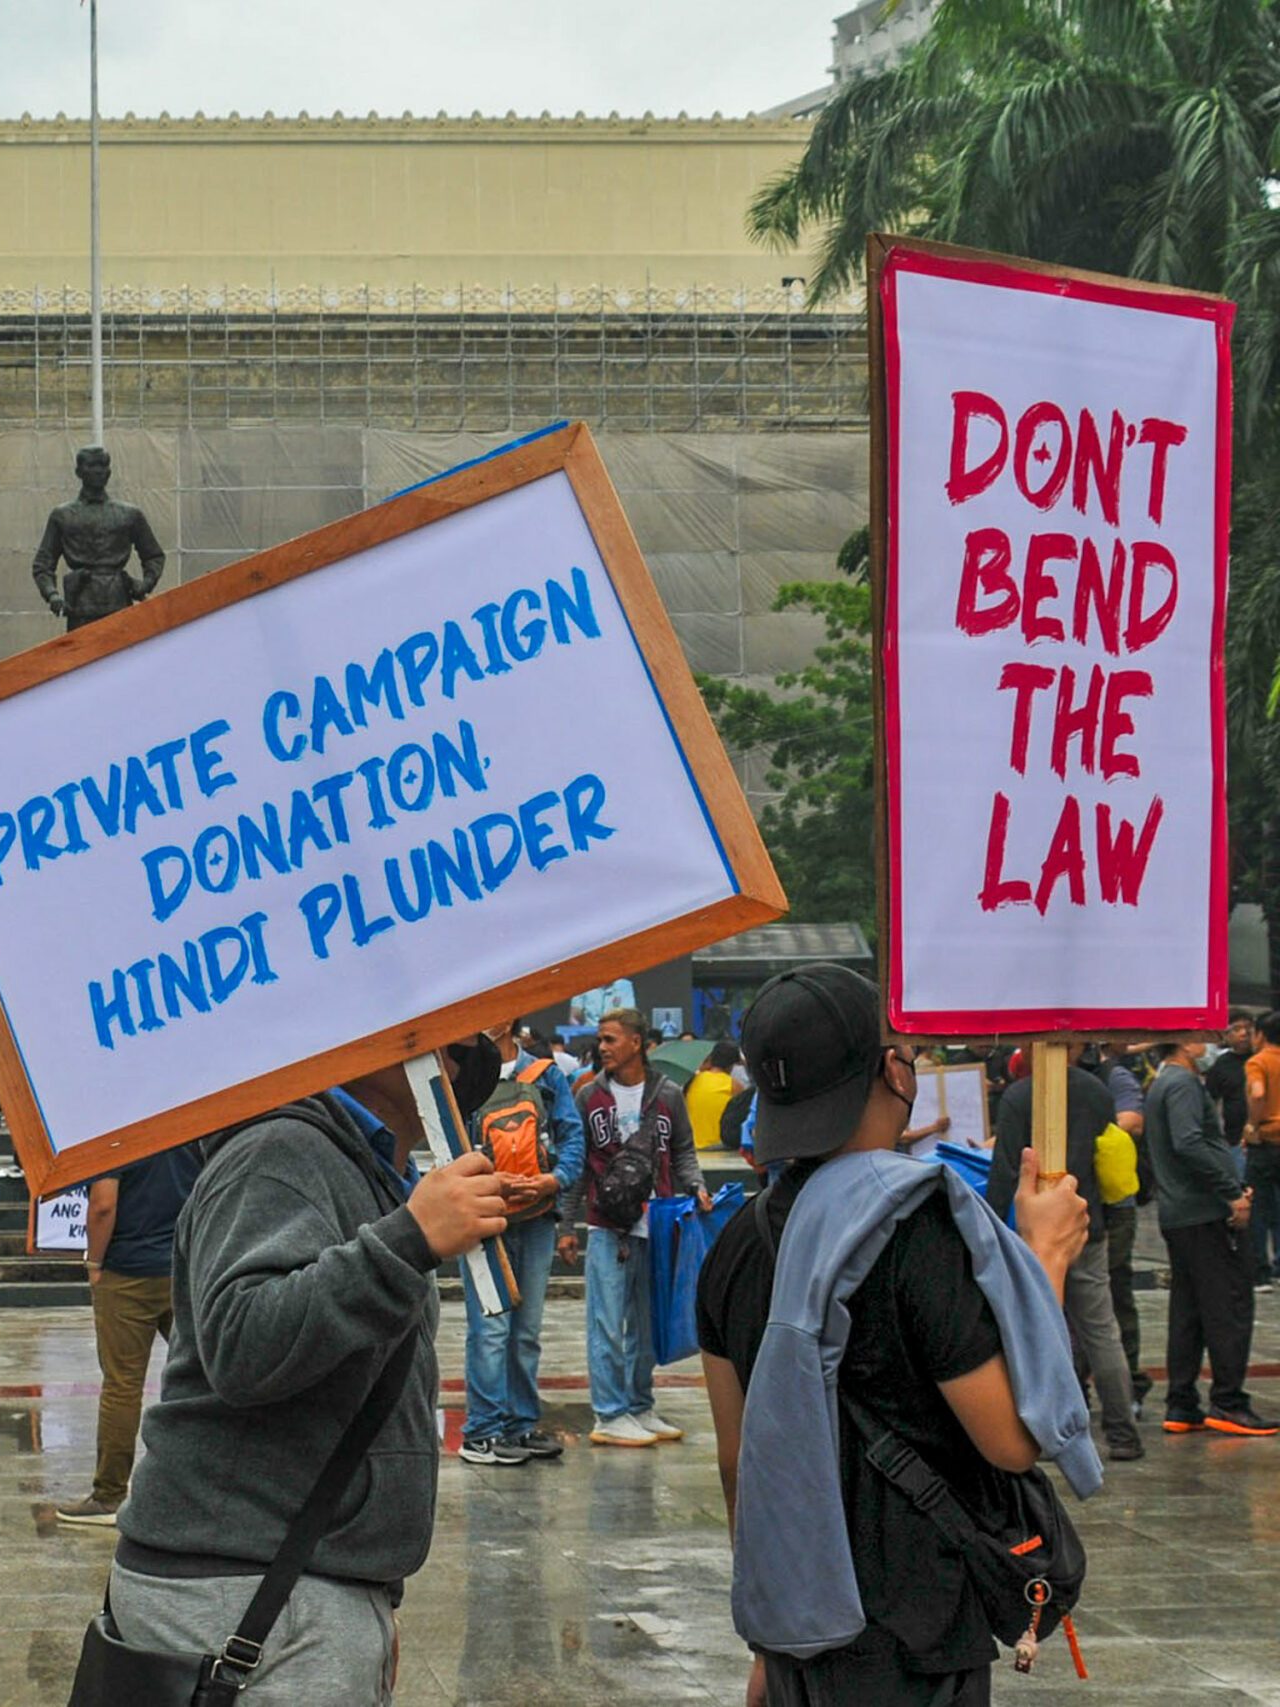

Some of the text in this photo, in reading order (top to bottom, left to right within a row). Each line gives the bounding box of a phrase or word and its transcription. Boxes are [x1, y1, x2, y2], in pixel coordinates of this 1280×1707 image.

[944, 390, 1188, 528] DON'T
[955, 528, 1178, 657] BEND
[262, 566, 602, 762] CAMPAIGN
[997, 662, 1153, 784] THE
[87, 773, 618, 1050] HINDI PLUNDER
[978, 792, 1163, 916] LAW
[50, 1203, 81, 1218] ANG
